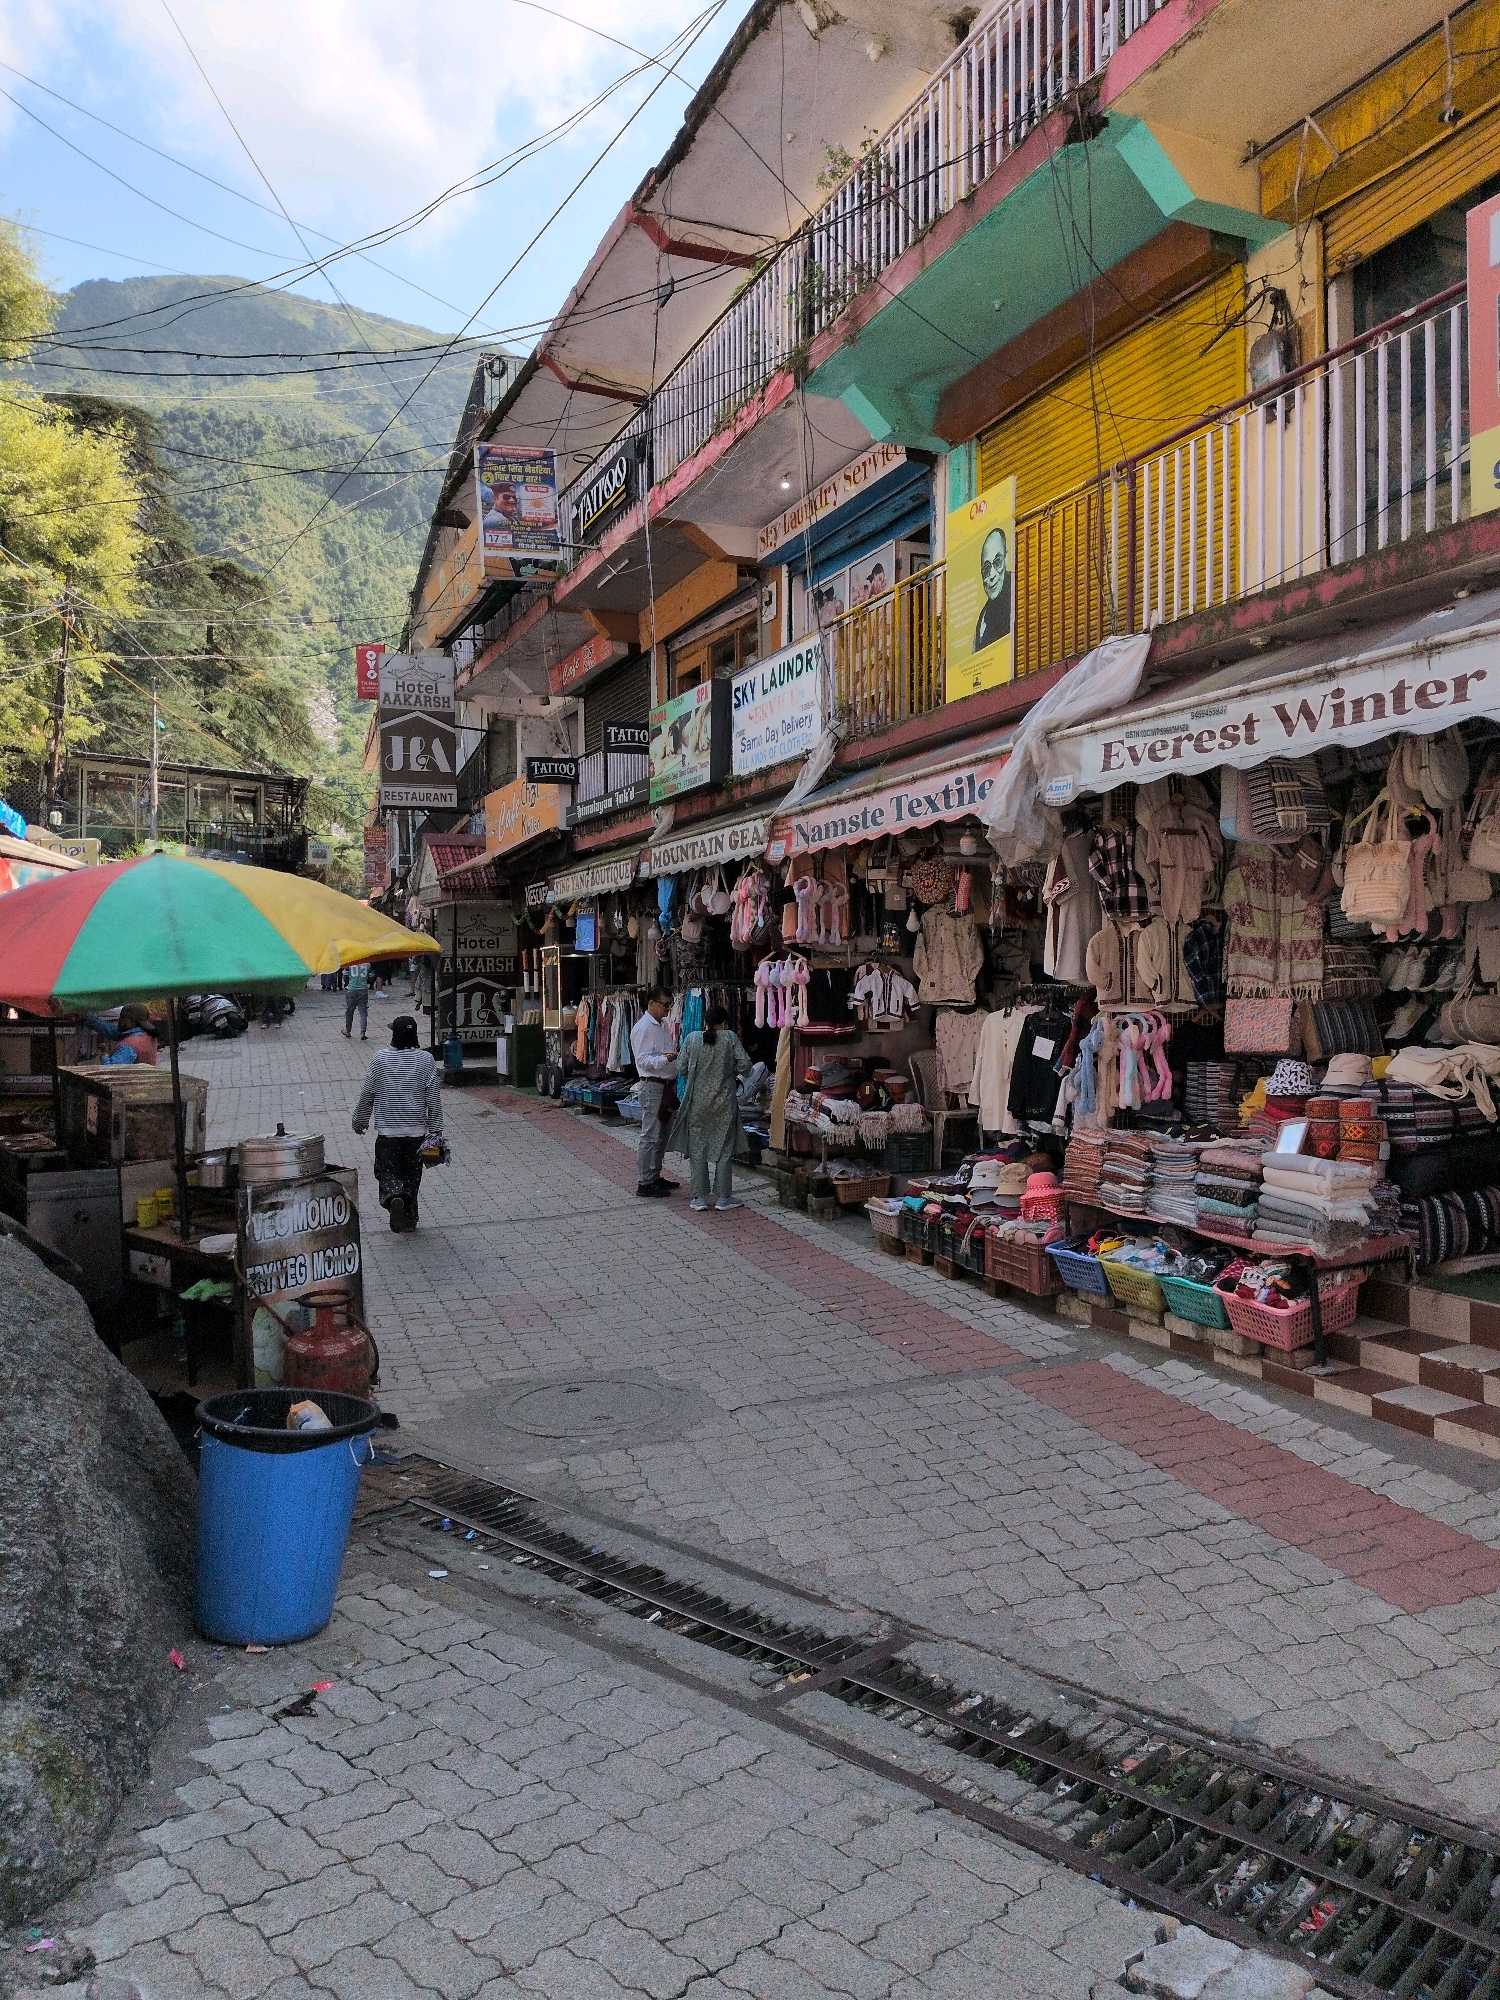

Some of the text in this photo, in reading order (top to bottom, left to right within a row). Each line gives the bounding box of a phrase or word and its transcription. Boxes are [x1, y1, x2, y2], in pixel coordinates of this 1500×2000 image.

[578, 456, 627, 539] TATTOO
[759, 522, 781, 553] Sky
[783, 478, 840, 536] Laundry
[366, 650, 377, 680] OYO
[734, 643, 822, 710] SKY LAUNDRY
[382, 692, 451, 708] AAKARSH
[395, 681, 439, 695] Hotel
[696, 685, 709, 703] SPA
[766, 726, 779, 743] Day
[781, 714, 813, 736] Delivery
[1100, 669, 1488, 774] Everest Winter
[769, 745, 777, 759] OF
[531, 761, 576, 776] TATTOO
[384, 790, 454, 803] RESTAURANT
[1047, 782, 1072, 792] Amrit
[794, 773, 995, 848] Namste Textile
[652, 833, 725, 870] MOUNTAIN
[571, 873, 589, 892] YANG
[590, 862, 630, 886] BOUTIQUE
[457, 936, 501, 950] Hotel
[442, 957, 515, 973] AAKARSH
[252, 1194, 347, 1242] VEG MOMO
[312, 1243, 358, 1281] MOMO
